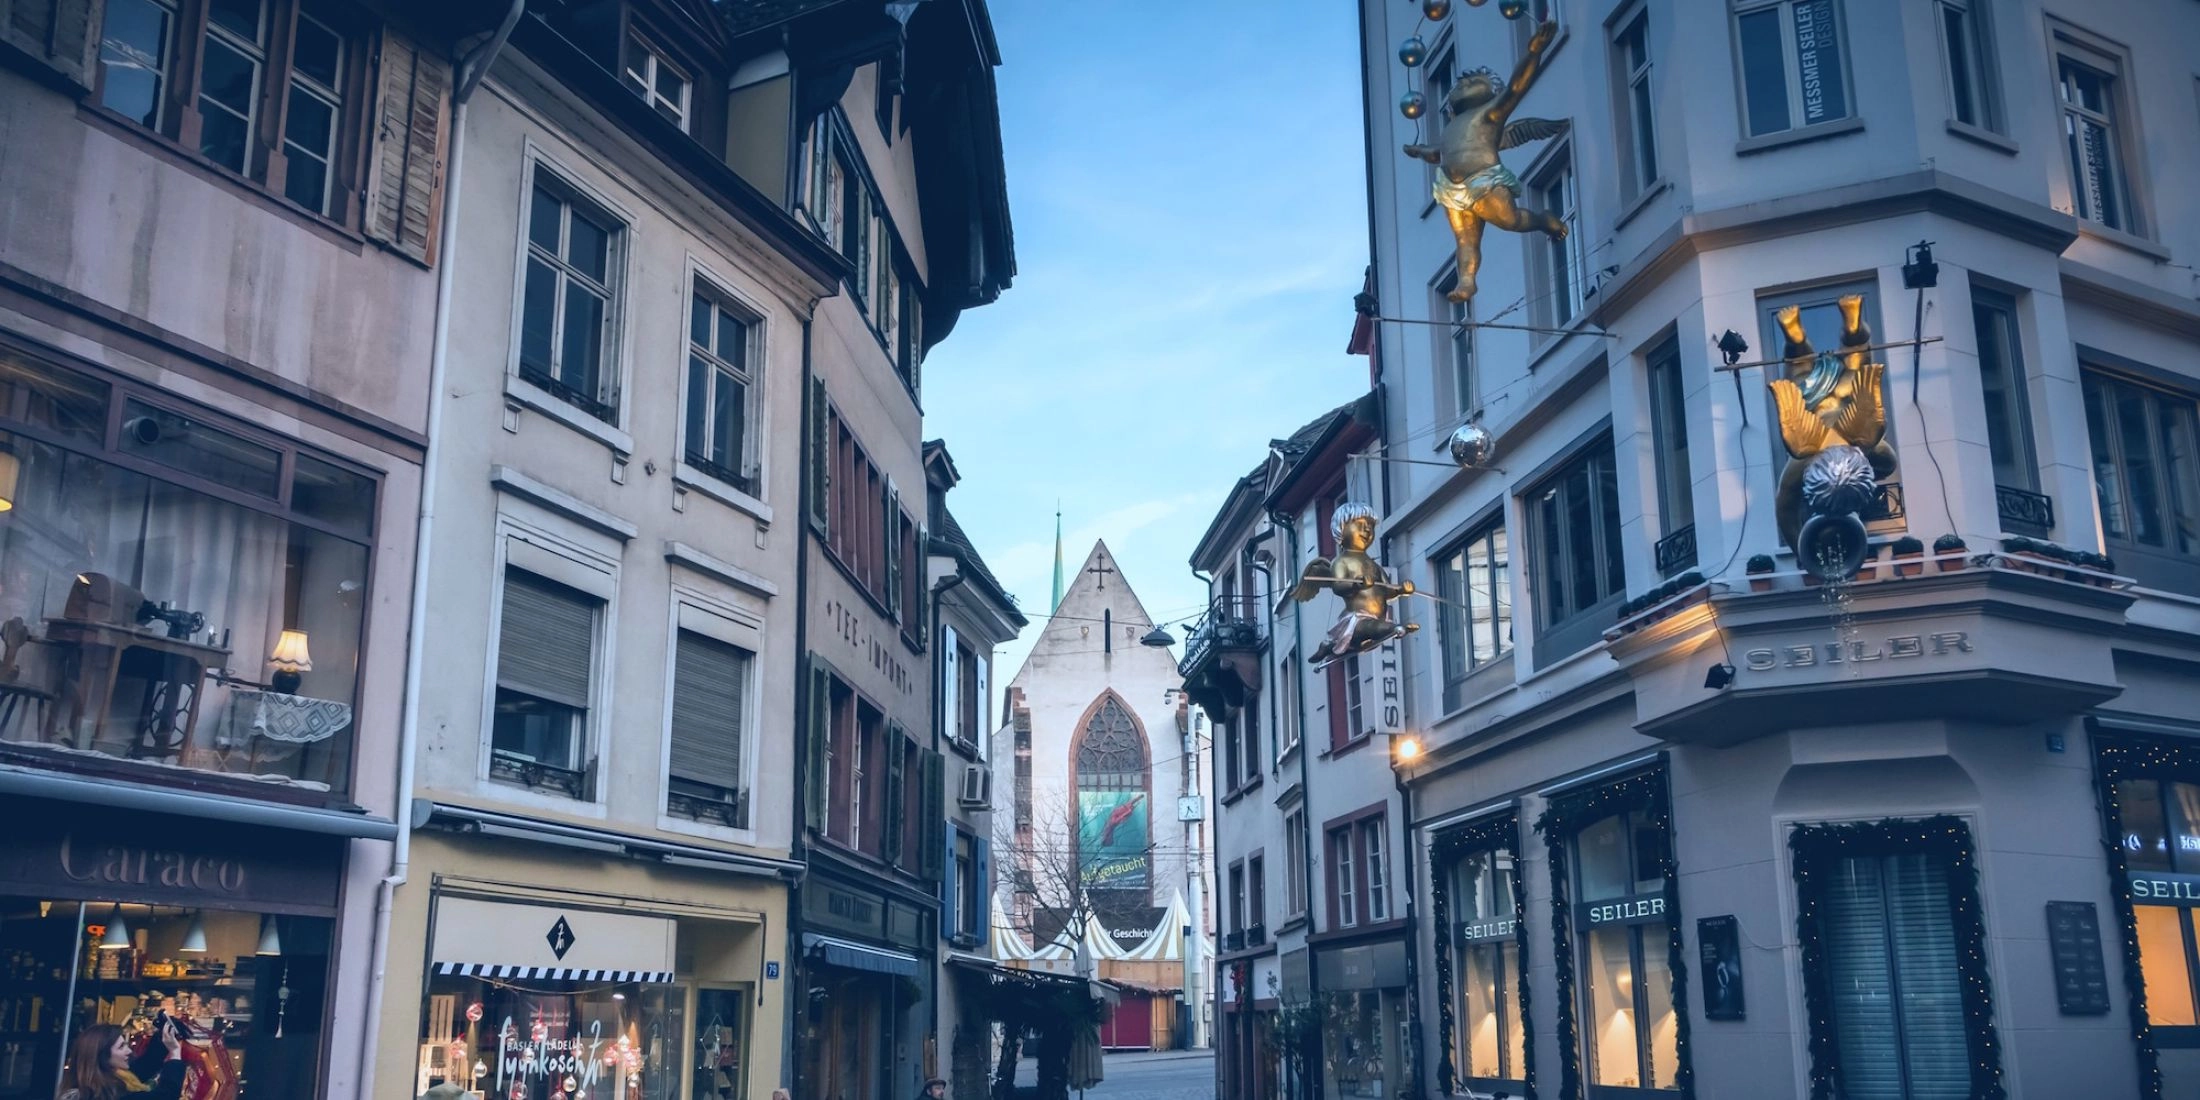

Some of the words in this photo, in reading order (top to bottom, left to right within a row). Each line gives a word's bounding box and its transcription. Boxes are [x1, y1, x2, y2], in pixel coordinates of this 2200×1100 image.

[1797, 3, 1816, 49] SEILER
[1814, 0, 1833, 48] DESIGN
[1802, 49, 1824, 119] MESSMER
[1745, 631, 1973, 671] SEILER
[60, 829, 245, 893] Caraco
[1589, 898, 1665, 923] SEILER
[768, 963, 777, 975] 79
